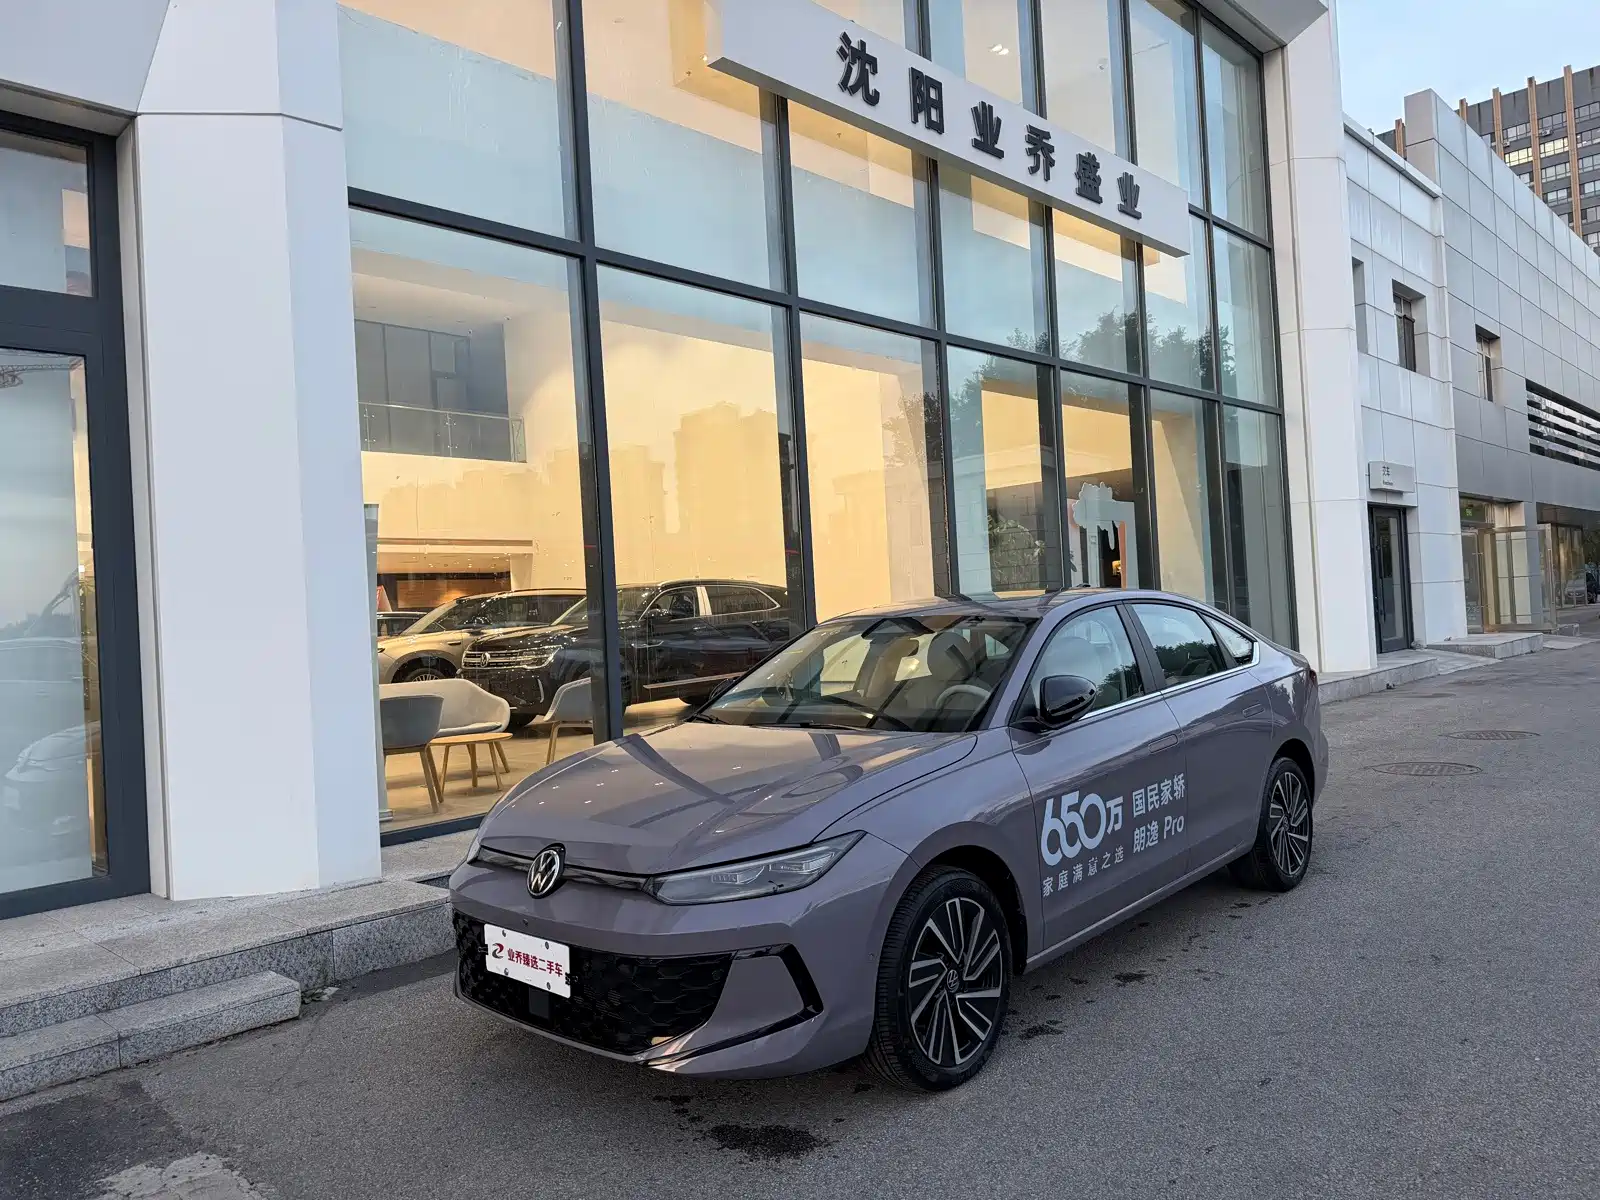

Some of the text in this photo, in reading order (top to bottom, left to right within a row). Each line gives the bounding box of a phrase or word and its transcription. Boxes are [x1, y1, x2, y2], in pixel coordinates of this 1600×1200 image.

[836, 31, 1142, 220] 沈阳业乔盛业
[1132, 773, 1185, 818] 国民家轿
[1133, 815, 1185, 853] 朗逸 Pro
[507, 948, 563, 977] 业乔臻选二手车
